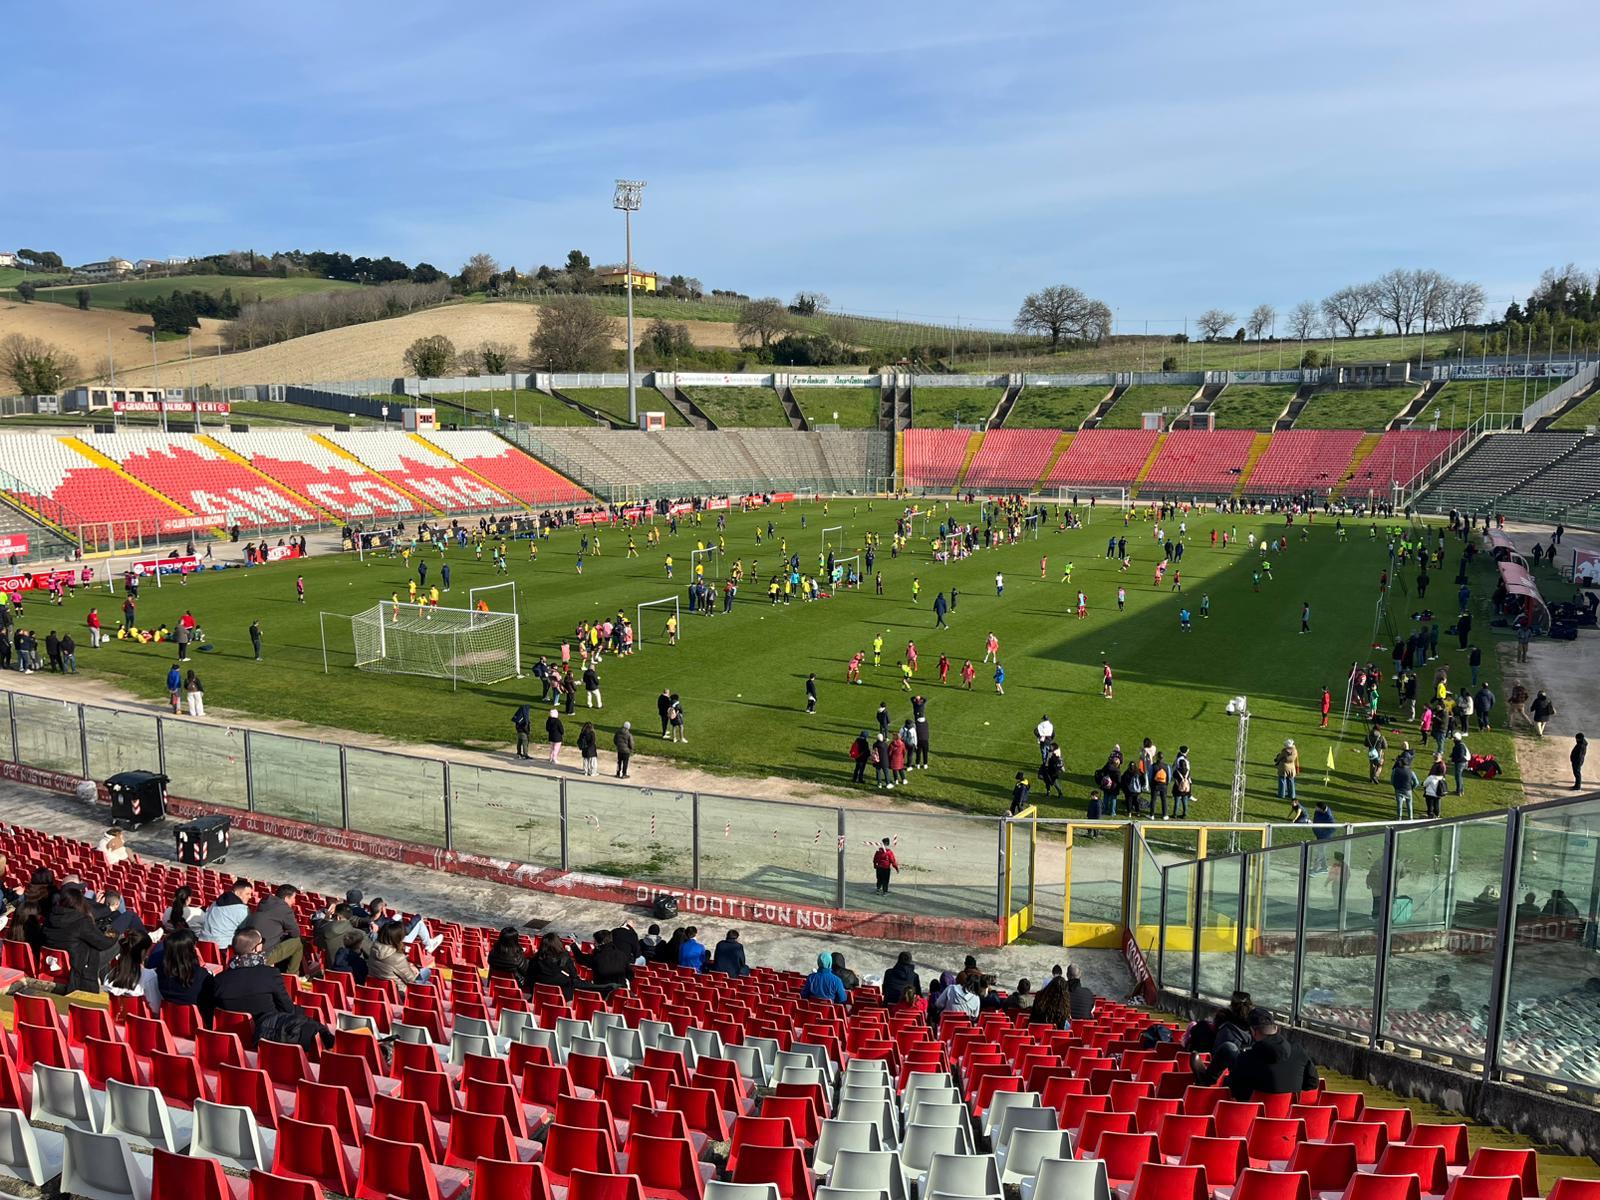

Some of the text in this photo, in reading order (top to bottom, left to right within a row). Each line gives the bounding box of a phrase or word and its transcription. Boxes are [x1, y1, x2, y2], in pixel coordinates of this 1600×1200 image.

[126, 402, 159, 411] GRADINATA
[190, 475, 510, 529] ANCONA
[753, 902, 791, 923] CON
[796, 909, 833, 931] NOI
